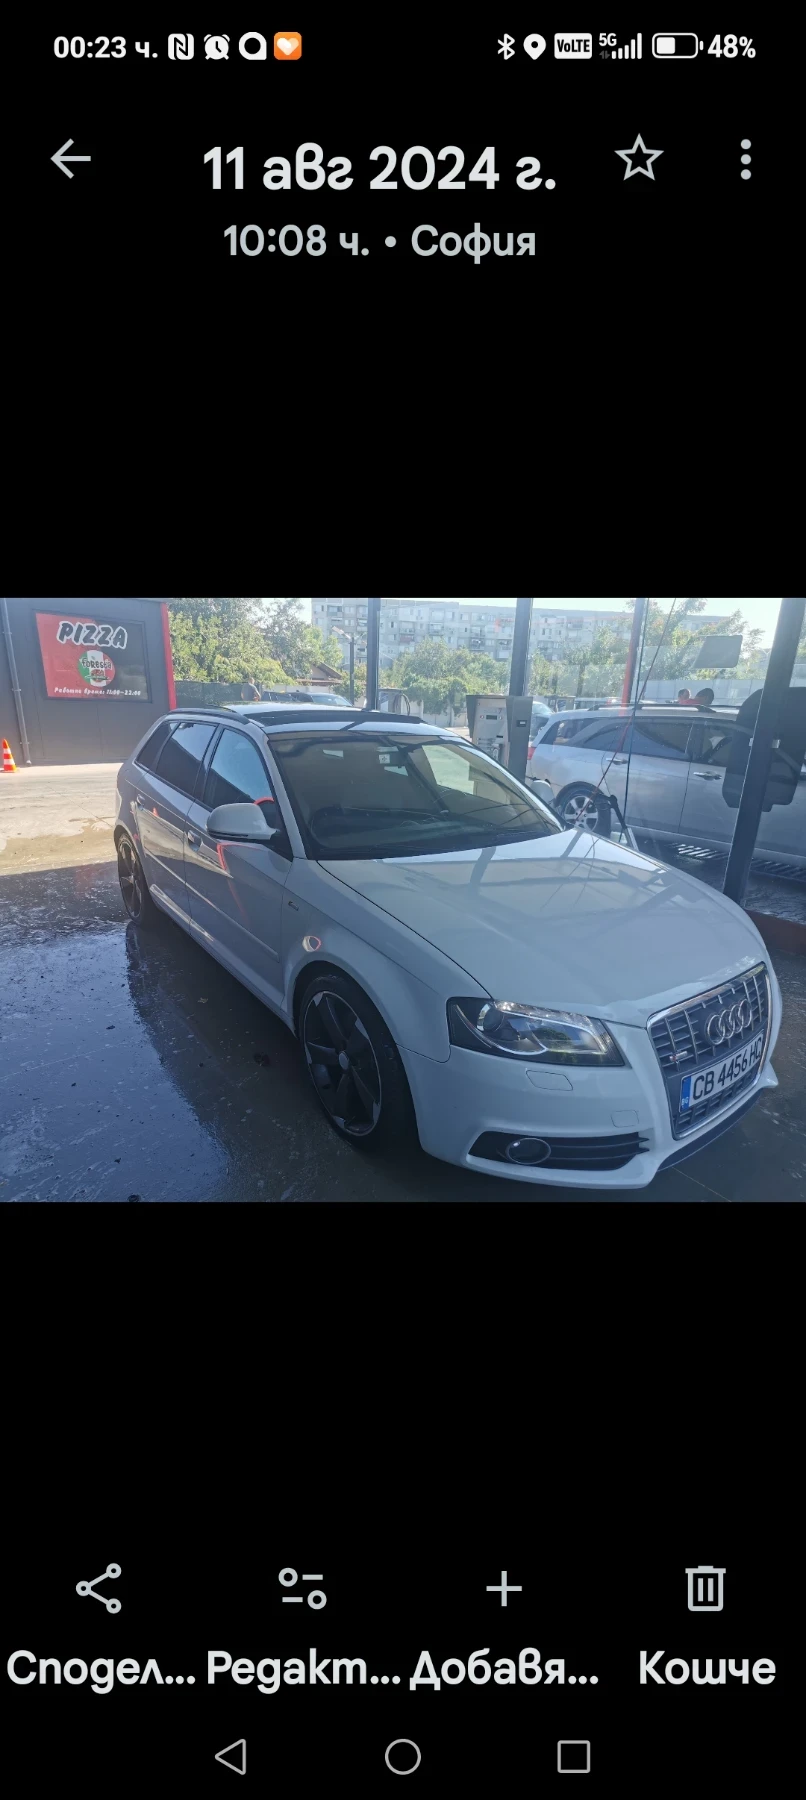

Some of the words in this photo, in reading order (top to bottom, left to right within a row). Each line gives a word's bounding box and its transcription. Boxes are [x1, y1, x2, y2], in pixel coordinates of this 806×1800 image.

[57, 620, 128, 649] PIZZA
[693, 1070, 715, 1100] CB
[717, 1049, 748, 1087] 4456
